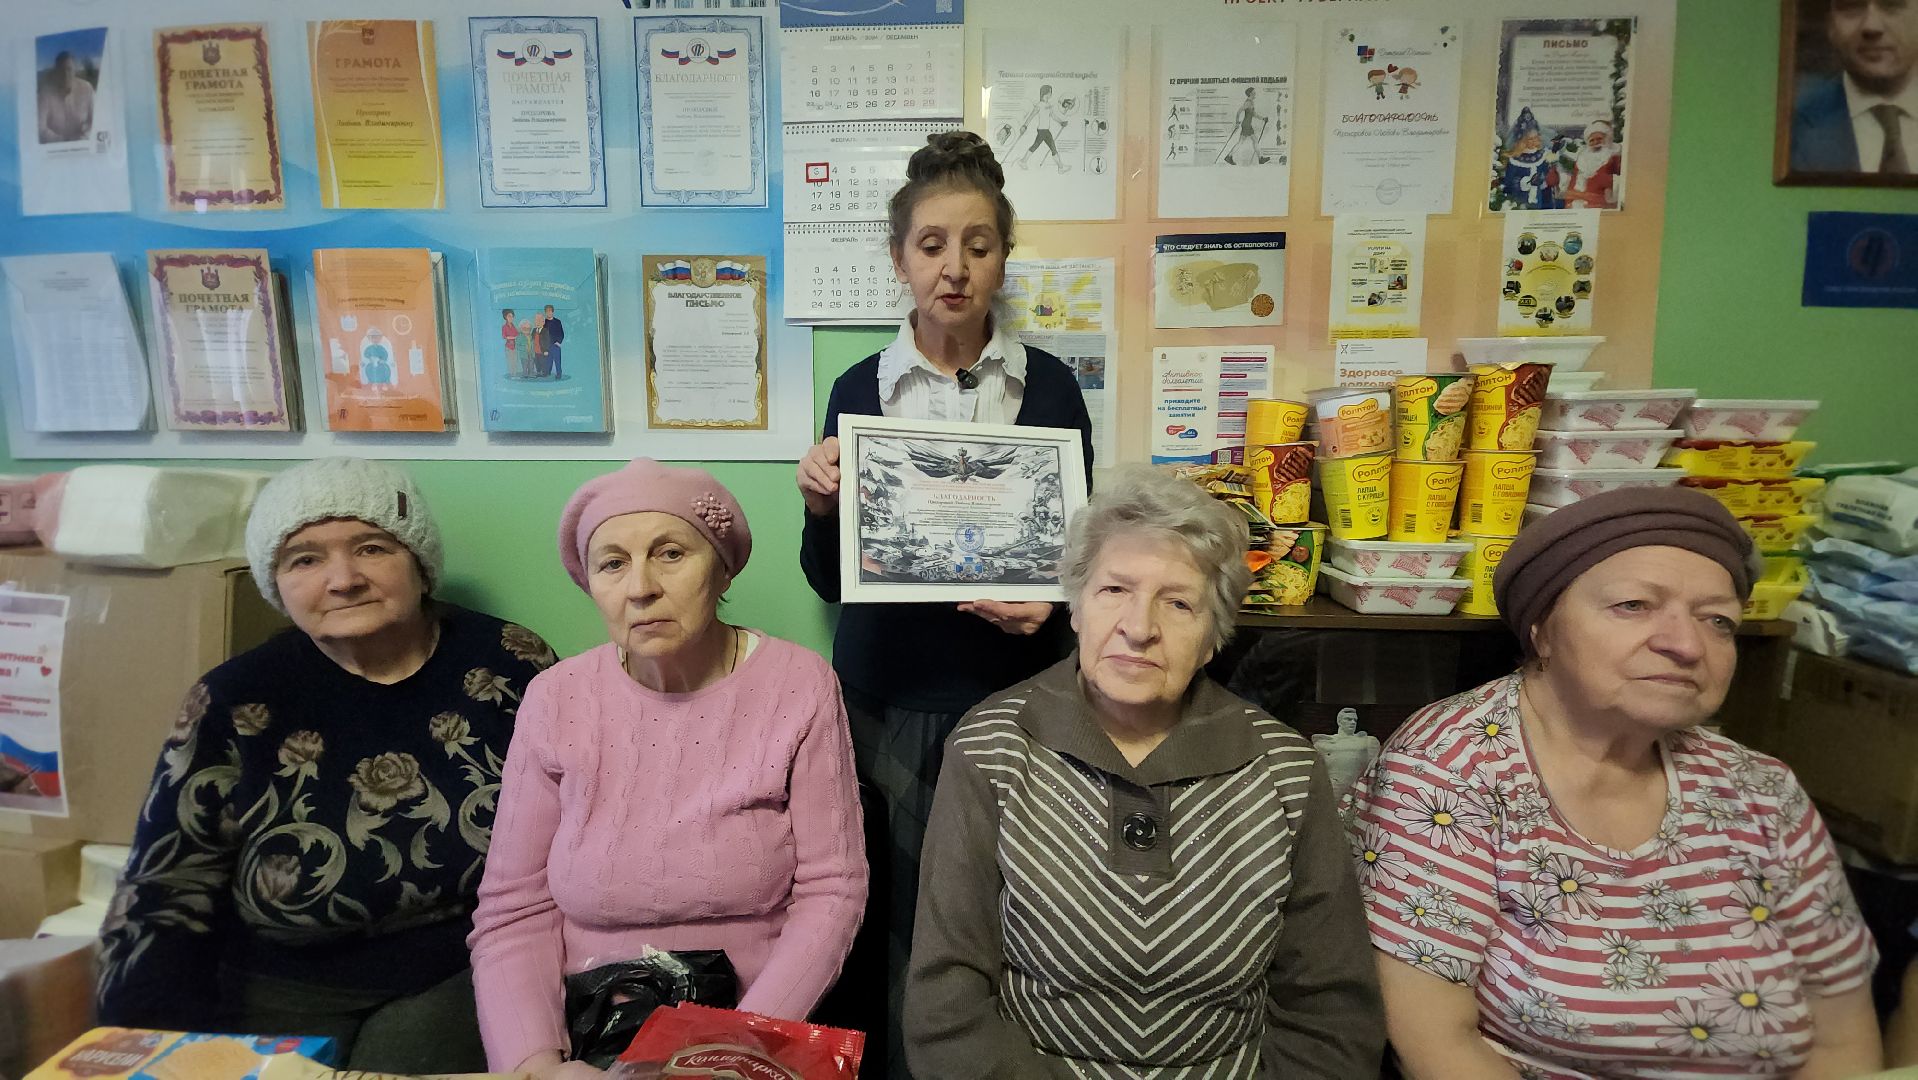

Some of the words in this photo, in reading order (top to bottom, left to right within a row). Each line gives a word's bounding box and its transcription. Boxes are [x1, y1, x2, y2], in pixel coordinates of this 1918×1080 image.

[1543, 39, 1588, 48] ПИСЬМО
[335, 57, 402, 69] ГРАМОТА
[811, 65, 818, 73] 2
[502, 71, 571, 84] ПОЧЕТНАЯ
[811, 78, 818, 86] 9
[1230, 76, 1260, 84] ФИНСКОЙ
[185, 80, 244, 91] ГРАМОТА
[509, 83, 566, 94] ГРАМОТА
[810, 90, 821, 98] 16
[884, 88, 897, 96] 20
[846, 101, 859, 109] 25
[884, 100, 897, 108] 27
[903, 99, 916, 107] 28
[850, 166, 857, 174] 5
[830, 179, 840, 187] 11
[811, 192, 822, 200] 17
[830, 191, 841, 199] 18
[866, 190, 878, 198] 20
[811, 204, 822, 212] 24
[829, 203, 841, 211] 25
[847, 202, 859, 210] 26
[866, 202, 878, 210] 27
[1163, 244, 1175, 252] ЧТО
[1176, 243, 1203, 251] СЛЕДУЕТ
[1233, 241, 1279, 250] ОСТЕОПОРОЗЕ?
[814, 266, 820, 274] 3
[832, 265, 839, 273] 4
[851, 265, 857, 273] 5
[869, 265, 876, 273] 6
[887, 265, 893, 273] 7
[848, 277, 860, 285] 12
[886, 277, 897, 285] 14
[812, 289, 823, 297] 17
[831, 289, 842, 297] 18
[849, 289, 860, 297] 19
[866, 289, 878, 297] 20
[885, 288, 896, 297] 21
[178, 293, 250, 304] ПОЧЕТНАЯ
[685, 300, 725, 308] ПИСЬМО
[811, 301, 823, 309] 24
[829, 301, 842, 309] 25
[848, 301, 860, 309] 26
[866, 301, 878, 309] 27
[885, 301, 897, 309] 28
[185, 304, 244, 314] ГРАМОТА
[1162, 369, 1203, 378] Активное
[1340, 368, 1403, 378] Здоровое
[1399, 386, 1434, 399] оллтон
[1341, 403, 1377, 417] Роллтон
[1357, 486, 1377, 494] ЛАПША
[1493, 483, 1515, 491] ЛАПША
